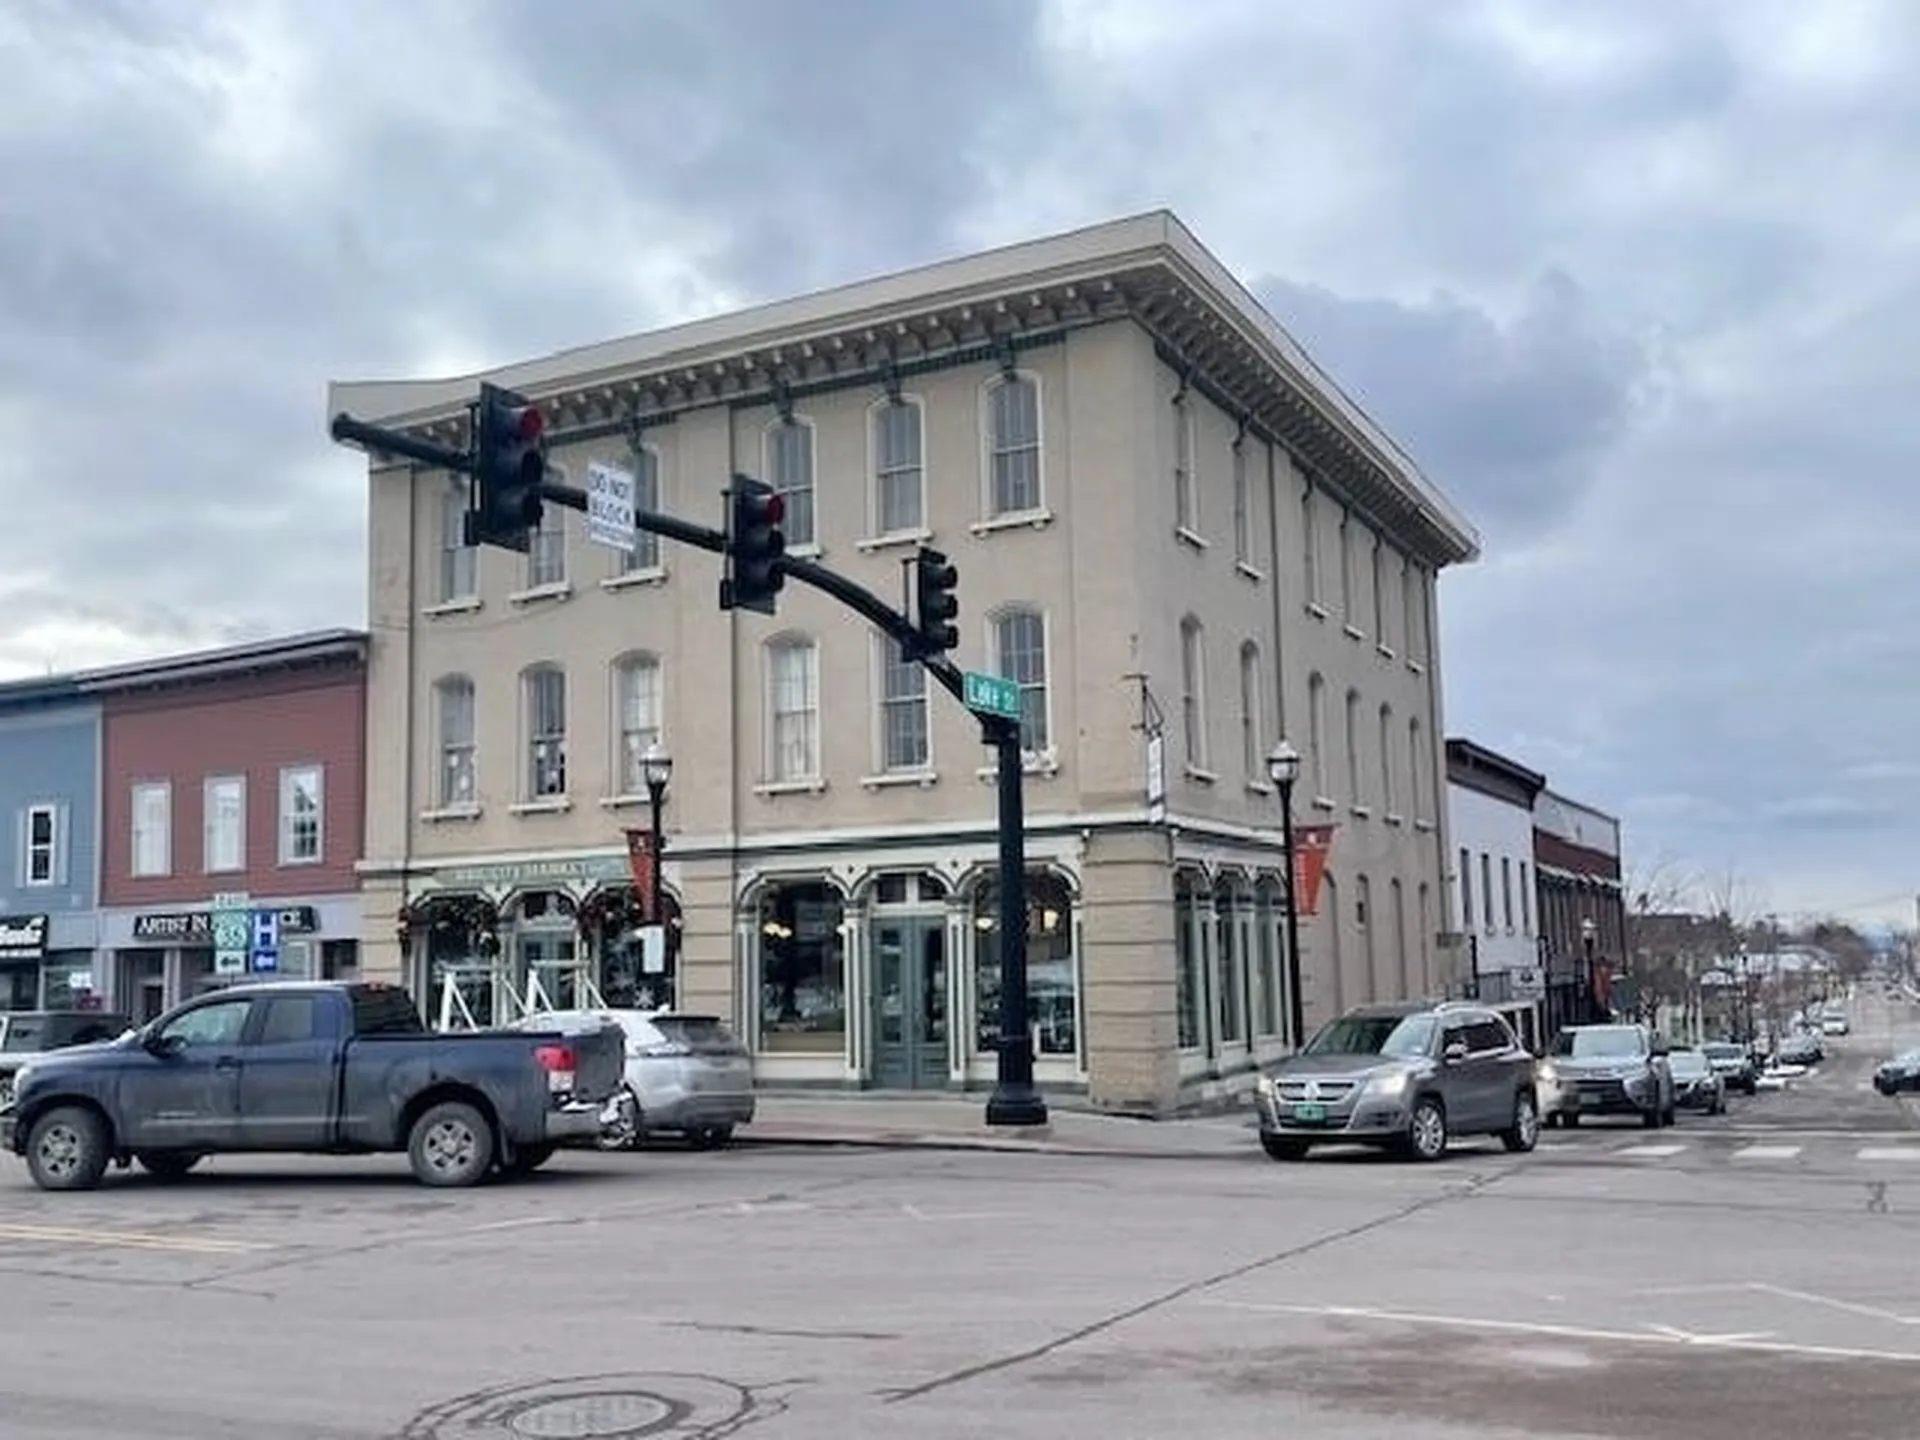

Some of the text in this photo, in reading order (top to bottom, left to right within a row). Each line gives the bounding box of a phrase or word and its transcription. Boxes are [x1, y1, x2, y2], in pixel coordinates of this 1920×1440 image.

[589, 469, 634, 500] DO NOT
[591, 496, 634, 525] BLOCK
[137, 914, 209, 935] ARTIST IN
[254, 912, 278, 946] H
